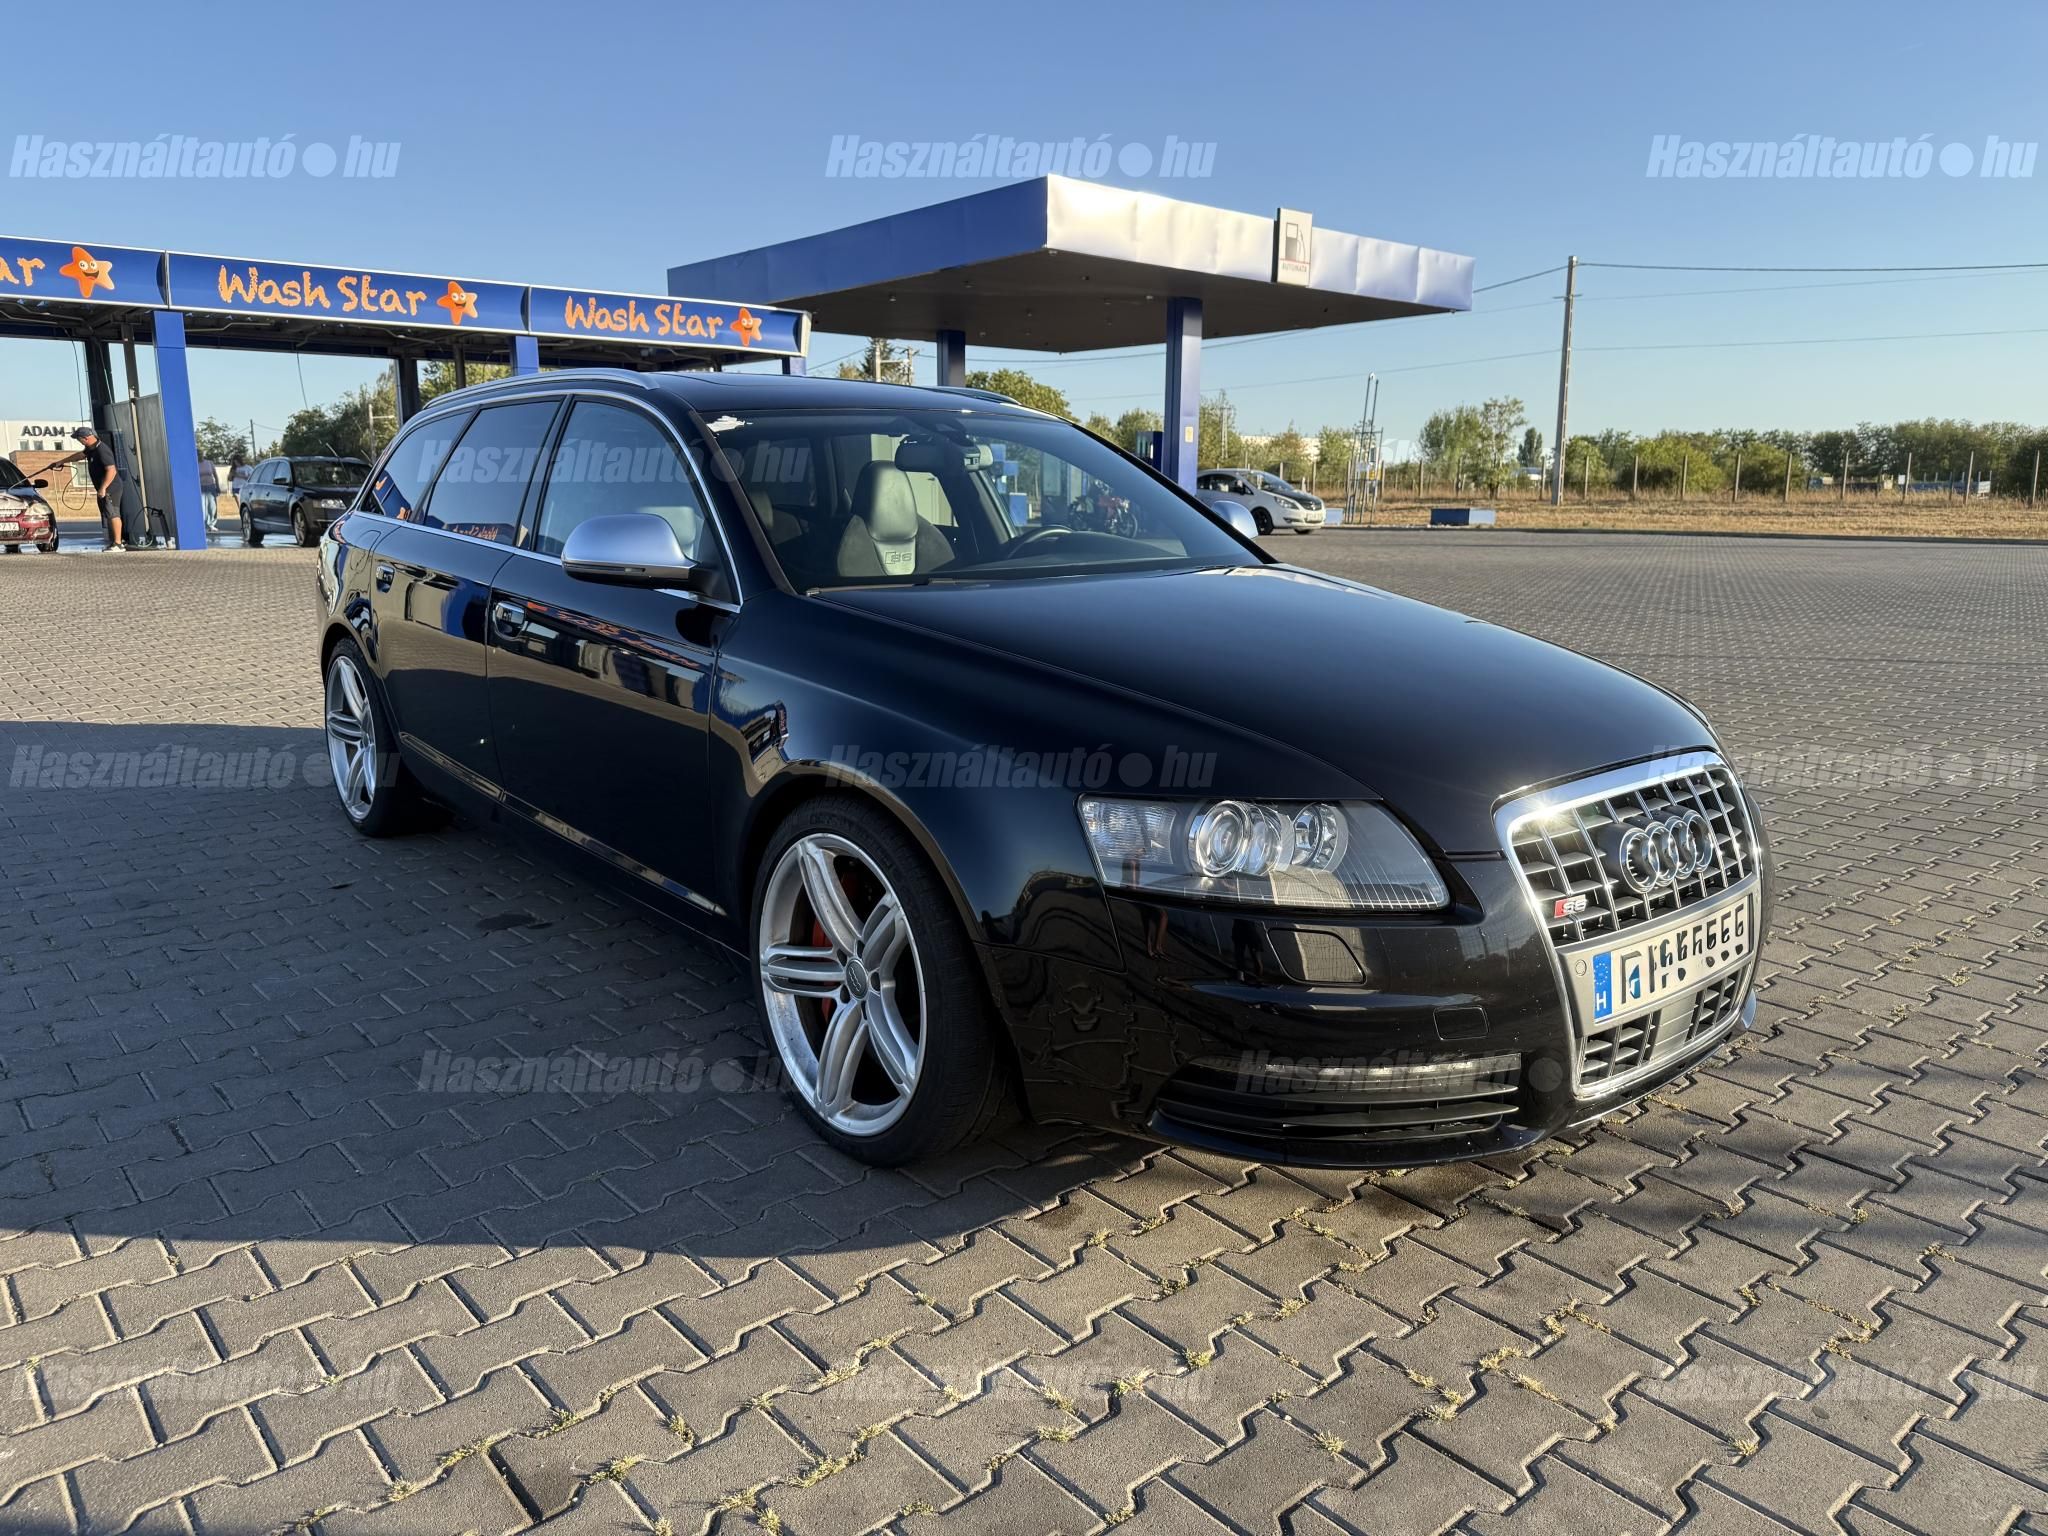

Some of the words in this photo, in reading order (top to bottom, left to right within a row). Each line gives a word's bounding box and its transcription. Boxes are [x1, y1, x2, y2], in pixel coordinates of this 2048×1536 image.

[218, 265, 330, 309] Wash
[337, 275, 427, 316] Star
[564, 296, 650, 333] Wash
[654, 303, 723, 339] Star
